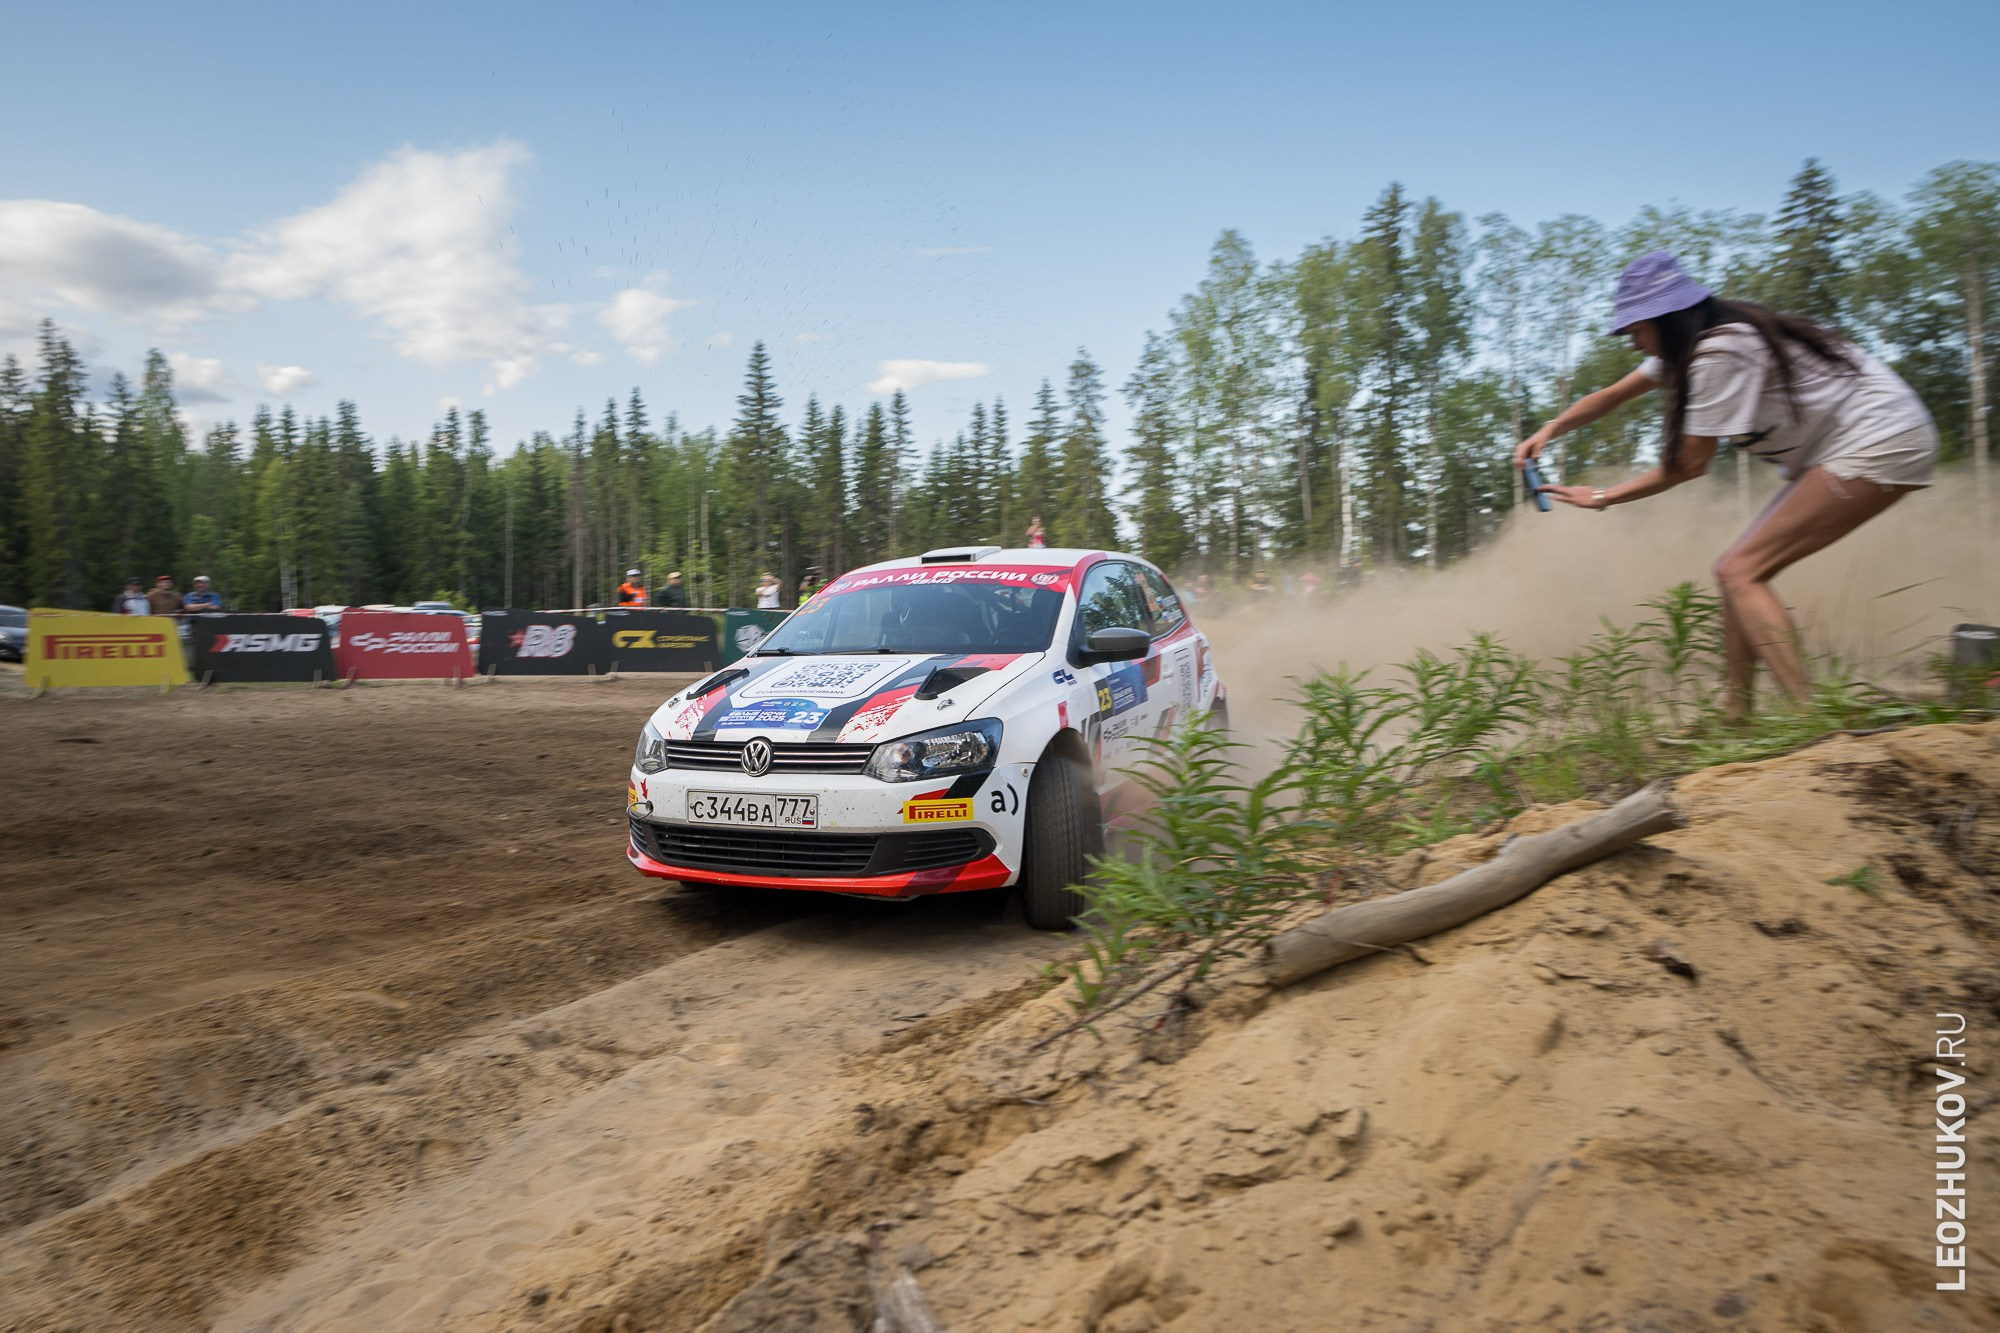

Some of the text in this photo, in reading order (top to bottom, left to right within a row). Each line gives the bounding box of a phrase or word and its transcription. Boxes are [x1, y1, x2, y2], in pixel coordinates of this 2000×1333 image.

[851, 571, 927, 588] РАЛЛИ
[931, 570, 1028, 581] РОССИИ
[795, 597, 832, 616] 23
[42, 633, 166, 660] PIRELLI
[382, 642, 459, 653] РОССИИ
[1098, 687, 1113, 712] 23
[787, 711, 824, 724] 23
[777, 798, 811, 817] 777
[908, 803, 967, 819] PIRELLI
[784, 816, 802, 825] RUS
